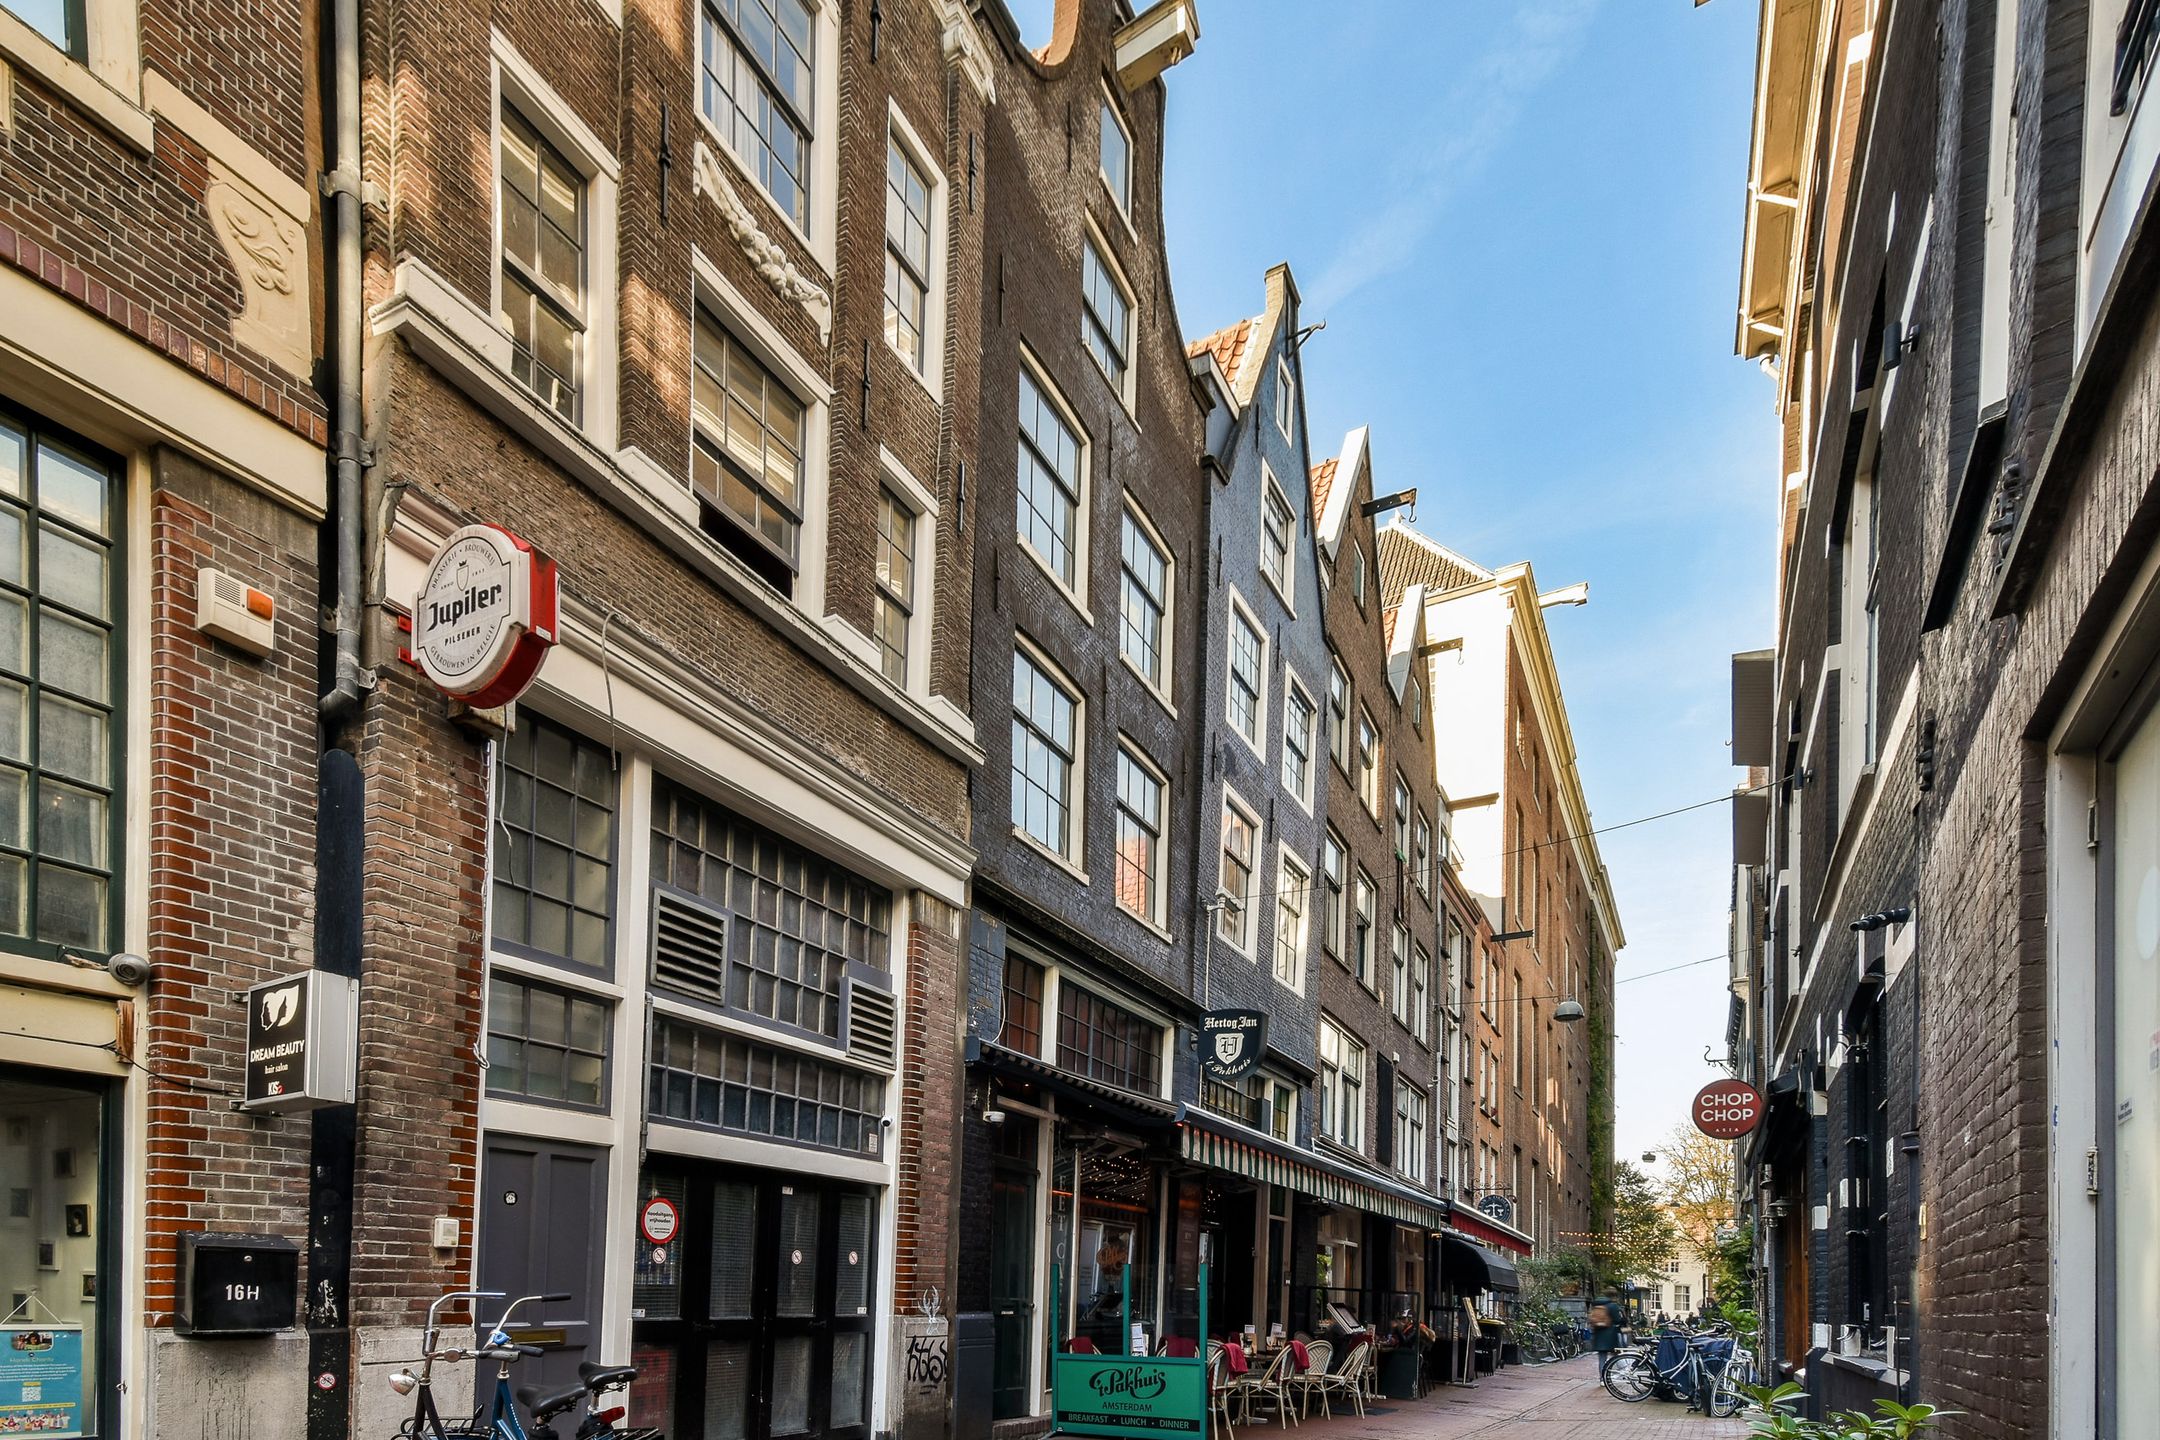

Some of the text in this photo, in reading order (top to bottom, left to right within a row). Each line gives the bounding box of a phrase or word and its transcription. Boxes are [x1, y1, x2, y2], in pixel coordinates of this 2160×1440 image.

[464, 543, 496, 566] BROUWERIJ
[426, 584, 502, 632] Jupiler
[445, 626, 481, 647] PILSENER
[430, 645, 466, 668] GEBROUWEN
[466, 653, 476, 664] IN
[1203, 1016, 1258, 1031] Hertog Jan
[250, 1039, 305, 1063] DREAM BEAUTY
[264, 1062, 289, 1075] hair salon
[1211, 1057, 1251, 1075] Pakhuis
[1700, 1092, 1754, 1107] CHOP
[1700, 1108, 1754, 1122] CHOP
[225, 1284, 260, 1301] 16H
[1089, 1366, 1166, 1400] Pakhuis
[1102, 1401, 1153, 1413] AMSTERDAM
[1068, 1413, 1190, 1429] BREAKFAST LUNCH DINNER
